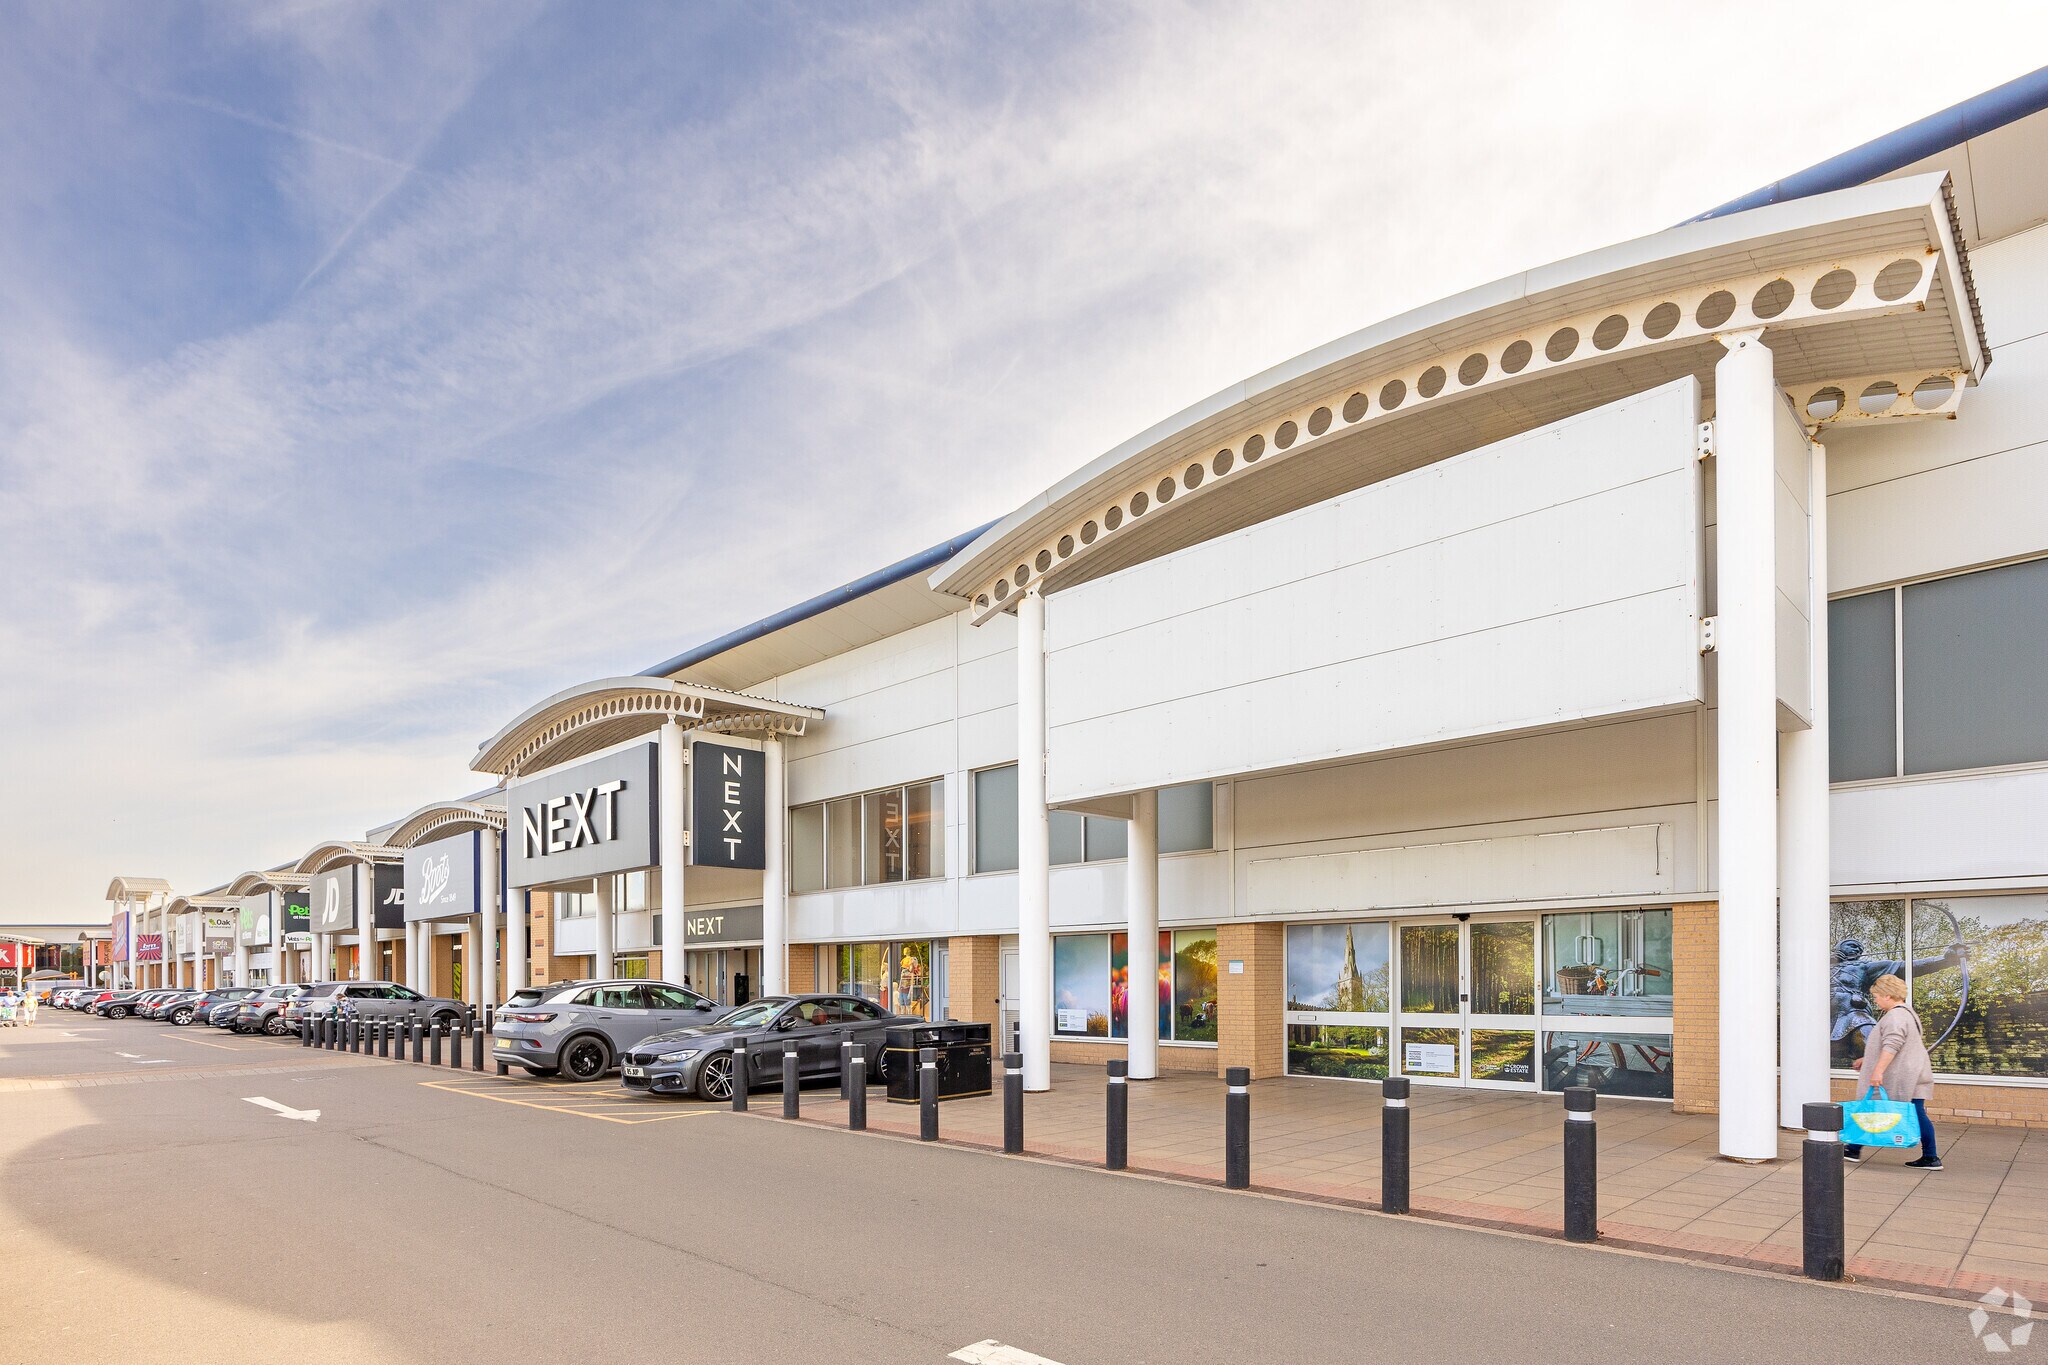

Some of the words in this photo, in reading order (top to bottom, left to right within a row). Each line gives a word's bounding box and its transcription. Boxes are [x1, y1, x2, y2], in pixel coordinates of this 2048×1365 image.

[523, 780, 627, 859] NEXT
[722, 752, 743, 861] NEXT
[322, 877, 340, 926] JD
[419, 853, 450, 905] Boots
[216, 918, 231, 926] Oak
[687, 916, 724, 936] NEXT
